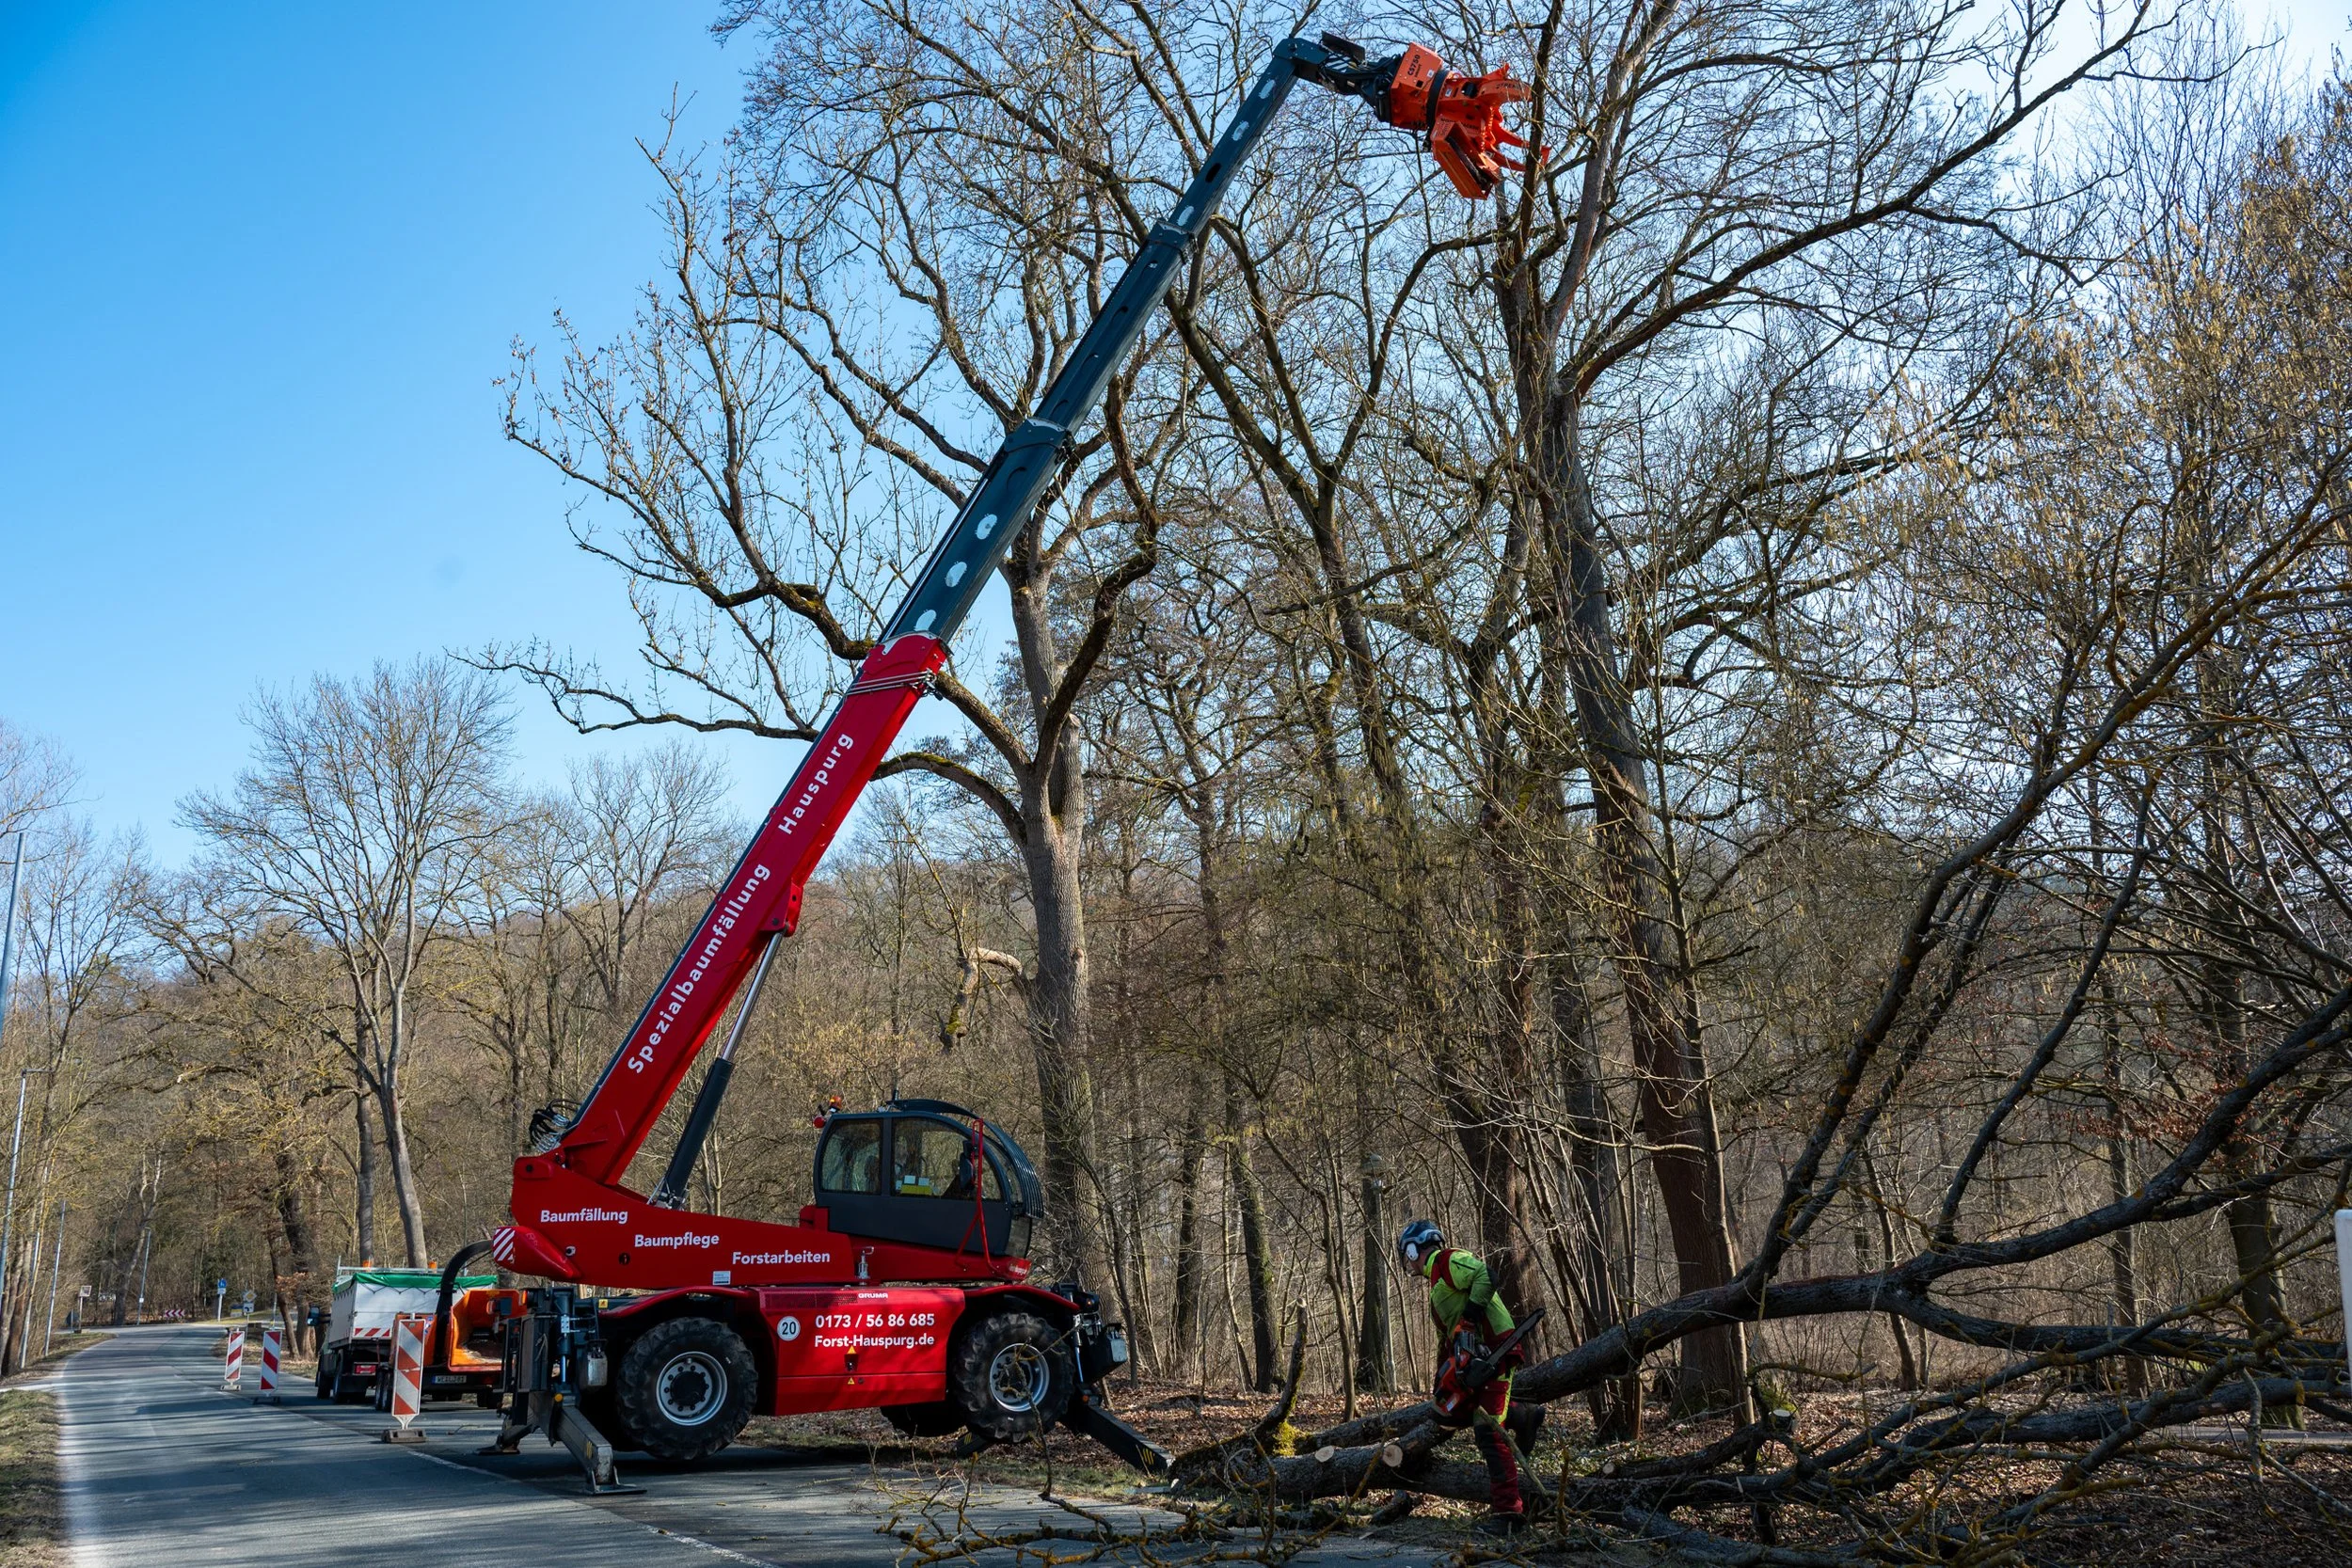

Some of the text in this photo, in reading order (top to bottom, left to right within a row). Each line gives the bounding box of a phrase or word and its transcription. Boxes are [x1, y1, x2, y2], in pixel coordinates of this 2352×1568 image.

[628, 734, 854, 1073] Spezialbaumfällung Hauspurg
[540, 1208, 628, 1225] Baumfällung
[634, 1231, 720, 1249] Baumpflege
[732, 1249, 831, 1265] Forstarbeiten
[782, 1322, 797, 1335] 20
[815, 1313, 935, 1328] 0173 / 56 86 685
[815, 1332, 934, 1349] Forst-Hauspurg.de
